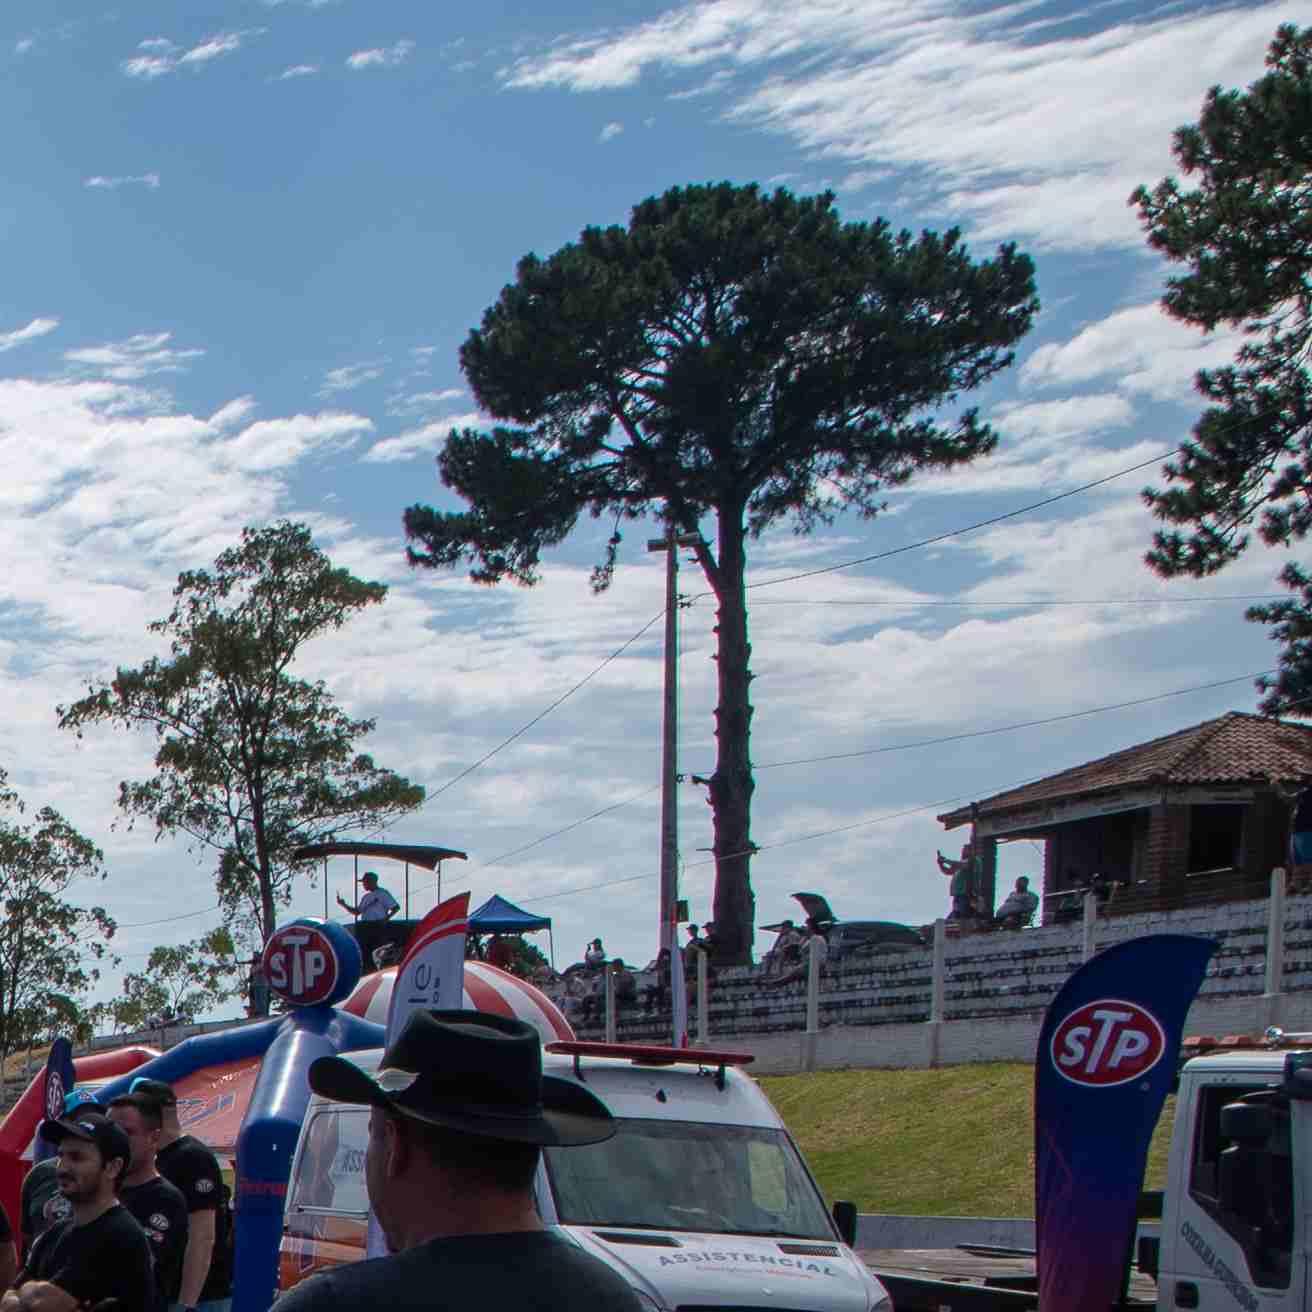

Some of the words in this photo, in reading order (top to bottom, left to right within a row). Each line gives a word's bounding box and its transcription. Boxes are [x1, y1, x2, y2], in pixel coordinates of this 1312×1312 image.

[269, 936, 326, 996] STP
[1060, 1009, 1150, 1075] STP
[658, 1250, 838, 1277] ASSISTENCIAL
